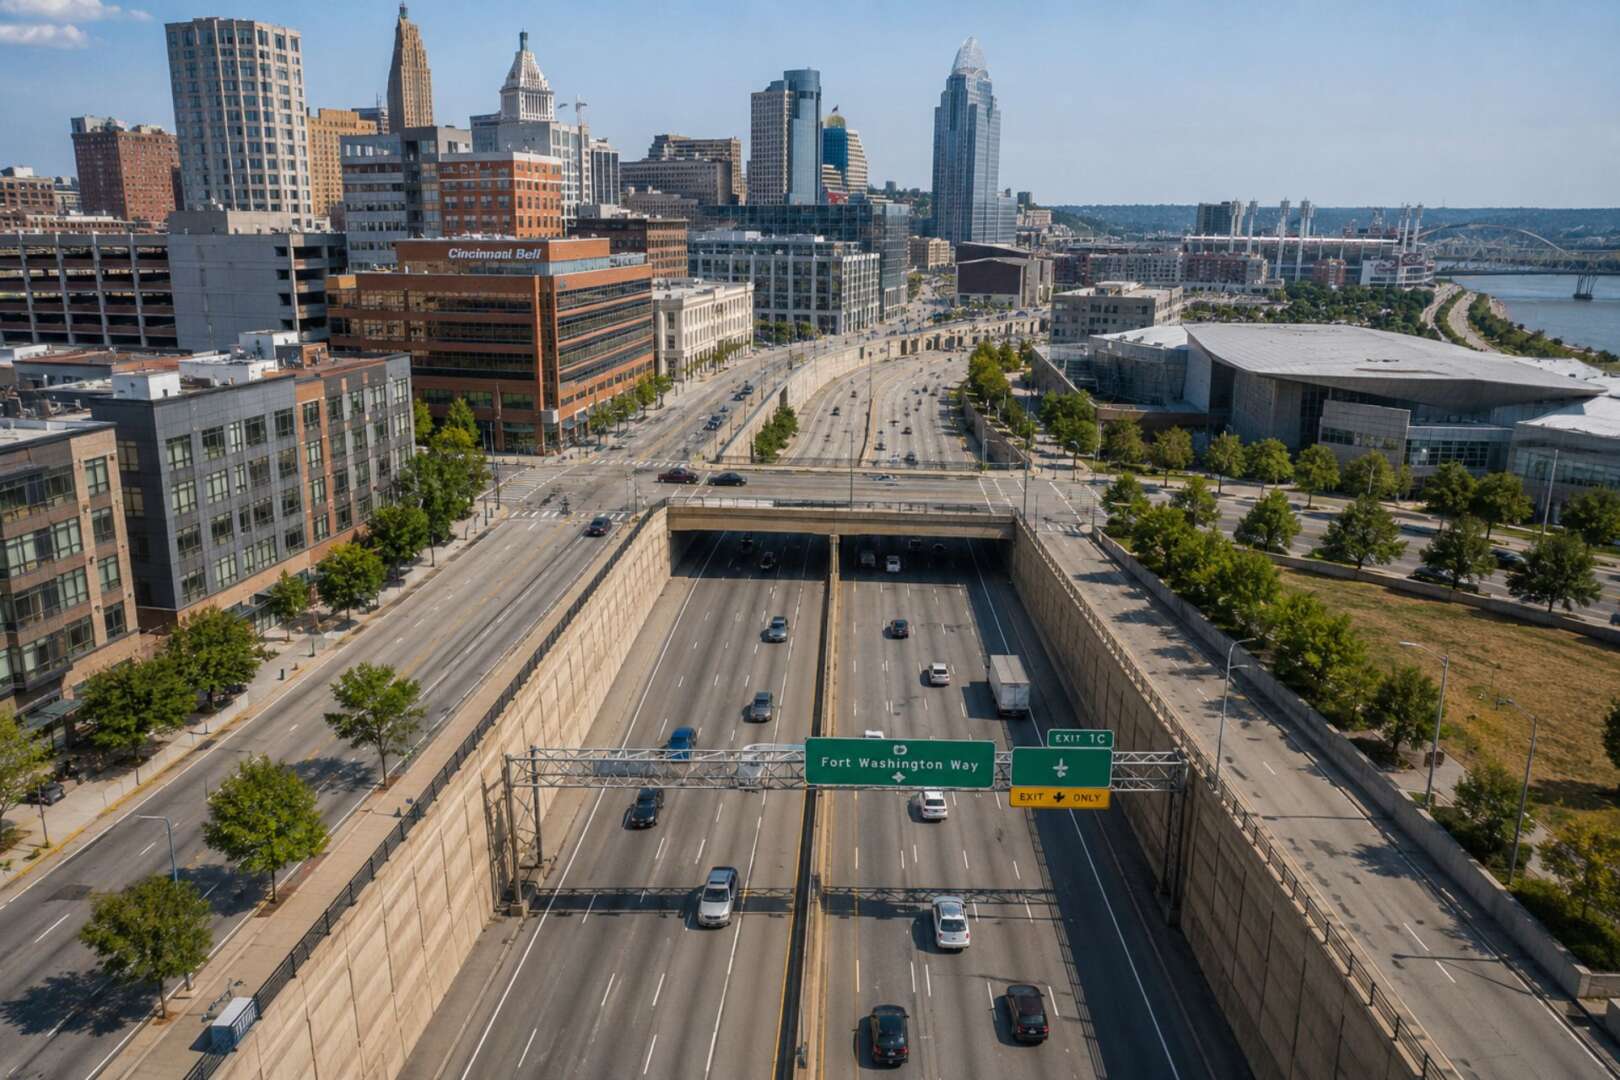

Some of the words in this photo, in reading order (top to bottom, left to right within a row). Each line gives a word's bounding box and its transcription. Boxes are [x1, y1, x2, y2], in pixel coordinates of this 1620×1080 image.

[516, 248, 542, 259] Bell
[1055, 734, 1080, 743] EXIT
[1090, 733, 1105, 743] 1C
[821, 757, 850, 768] Fort
[859, 757, 943, 772] Washington
[951, 759, 978, 773] Way
[1019, 792, 1044, 801] EXIT
[1073, 793, 1102, 802] ONLY
